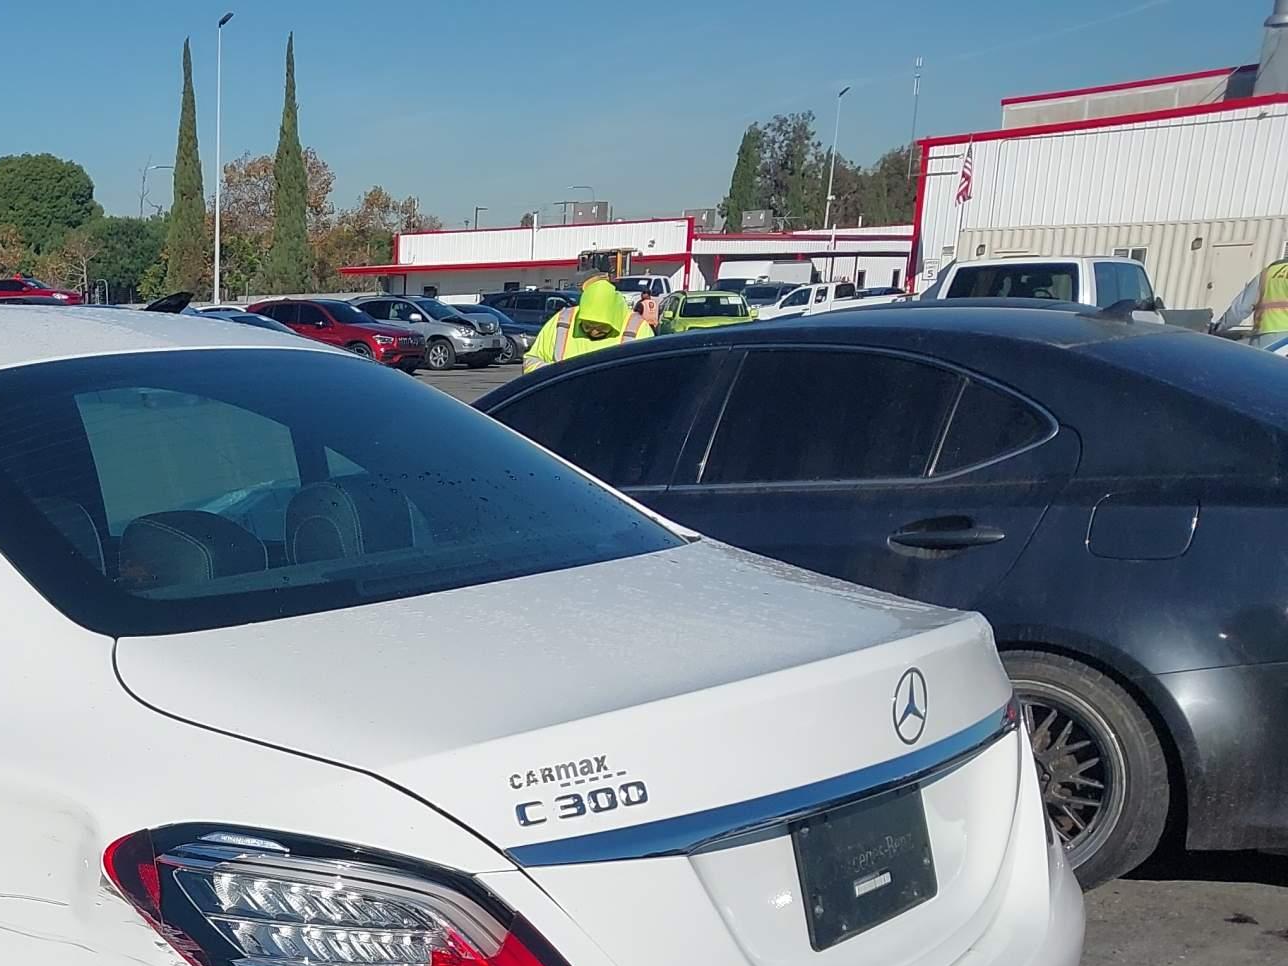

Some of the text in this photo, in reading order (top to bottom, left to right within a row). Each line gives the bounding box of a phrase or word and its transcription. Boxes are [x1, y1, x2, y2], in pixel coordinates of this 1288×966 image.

[927, 269, 934, 278] 5
[515, 780, 650, 827] C 300
